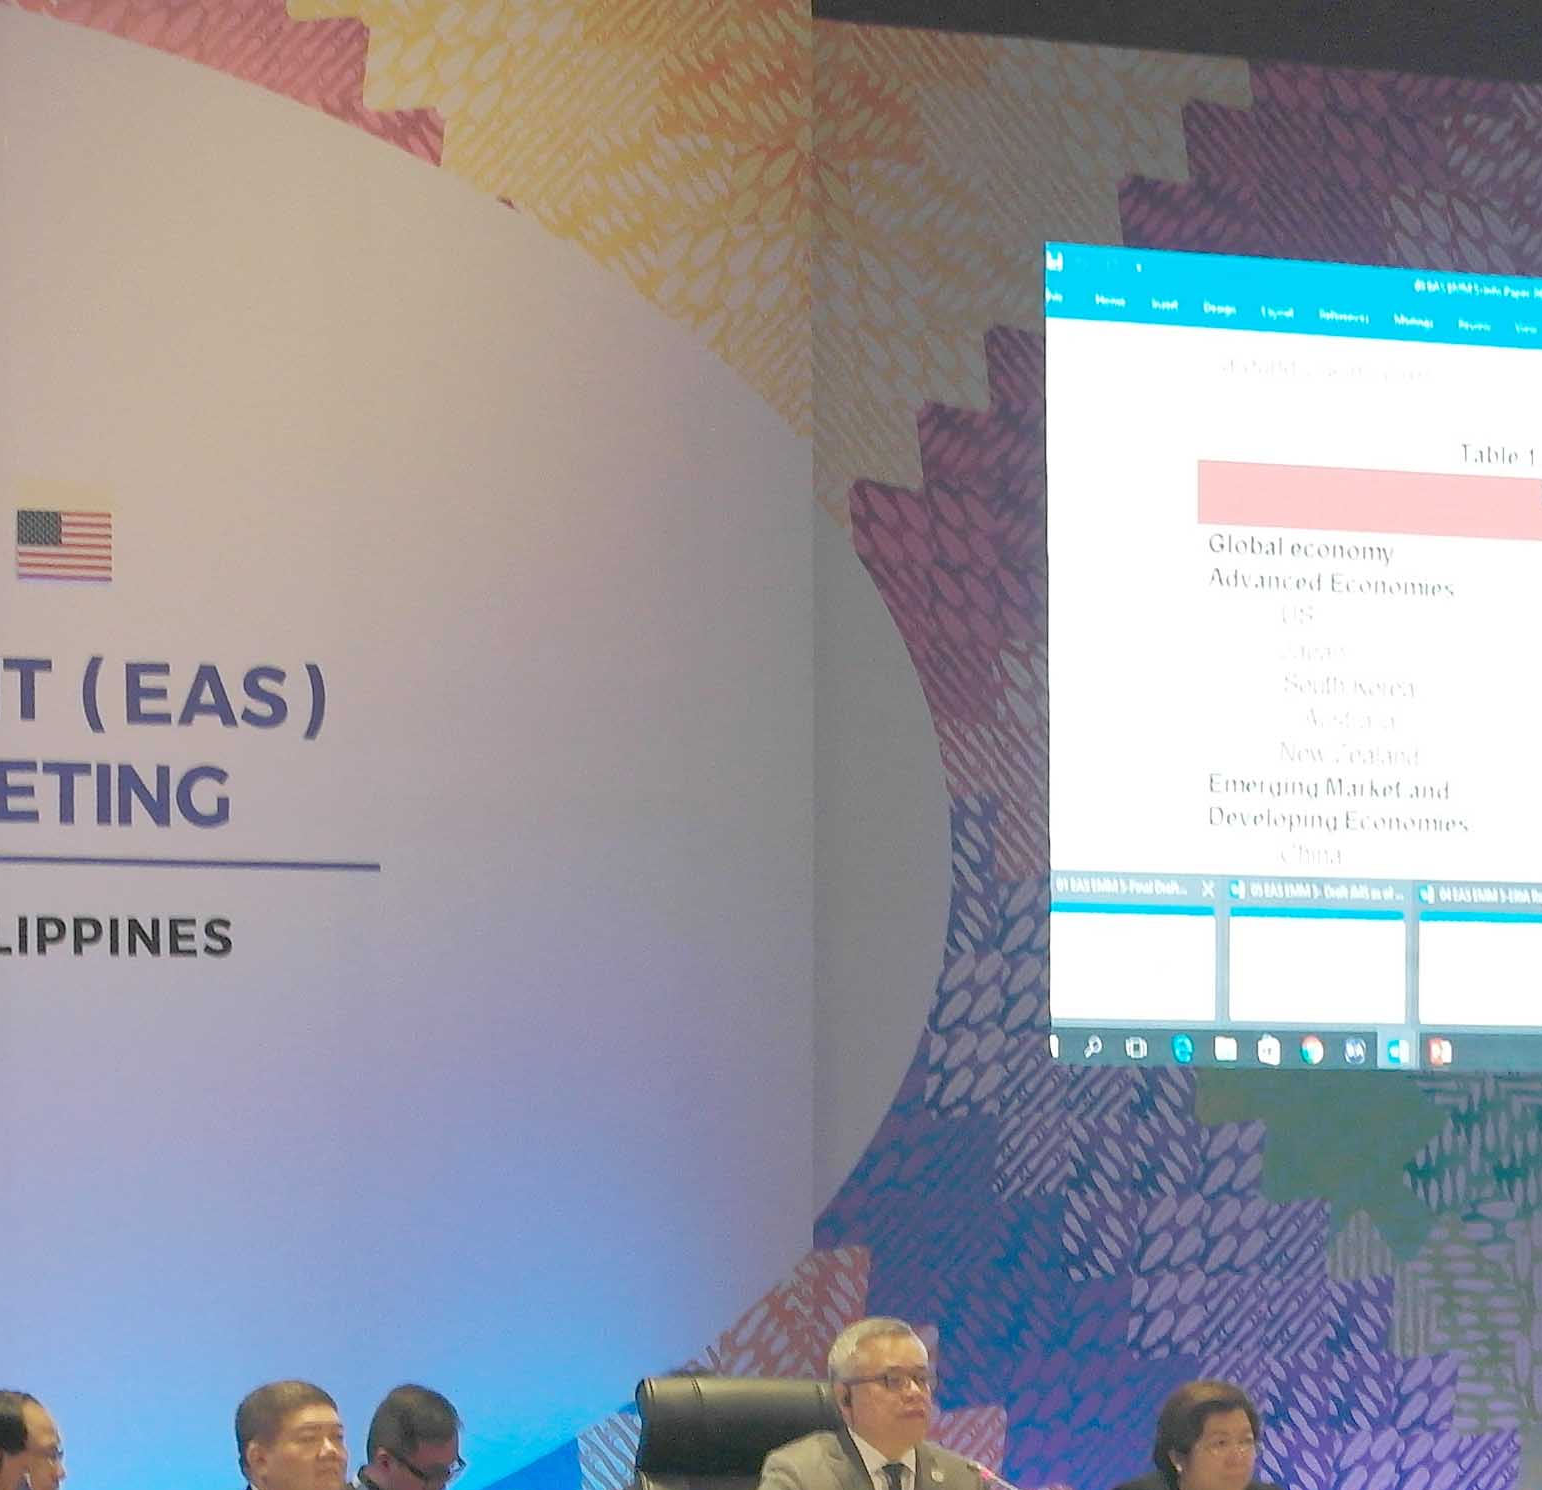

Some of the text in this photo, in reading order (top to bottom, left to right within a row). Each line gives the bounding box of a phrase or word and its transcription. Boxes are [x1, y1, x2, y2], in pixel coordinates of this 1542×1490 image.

[1209, 533, 1284, 556] Global
[1290, 538, 1395, 565] economy
[1209, 568, 1322, 592] Advanced
[1330, 571, 1457, 598] Economies
[1209, 773, 1319, 799] Emerging
[1326, 776, 1402, 800] Market
[1209, 806, 1471, 834] Developing Economies
